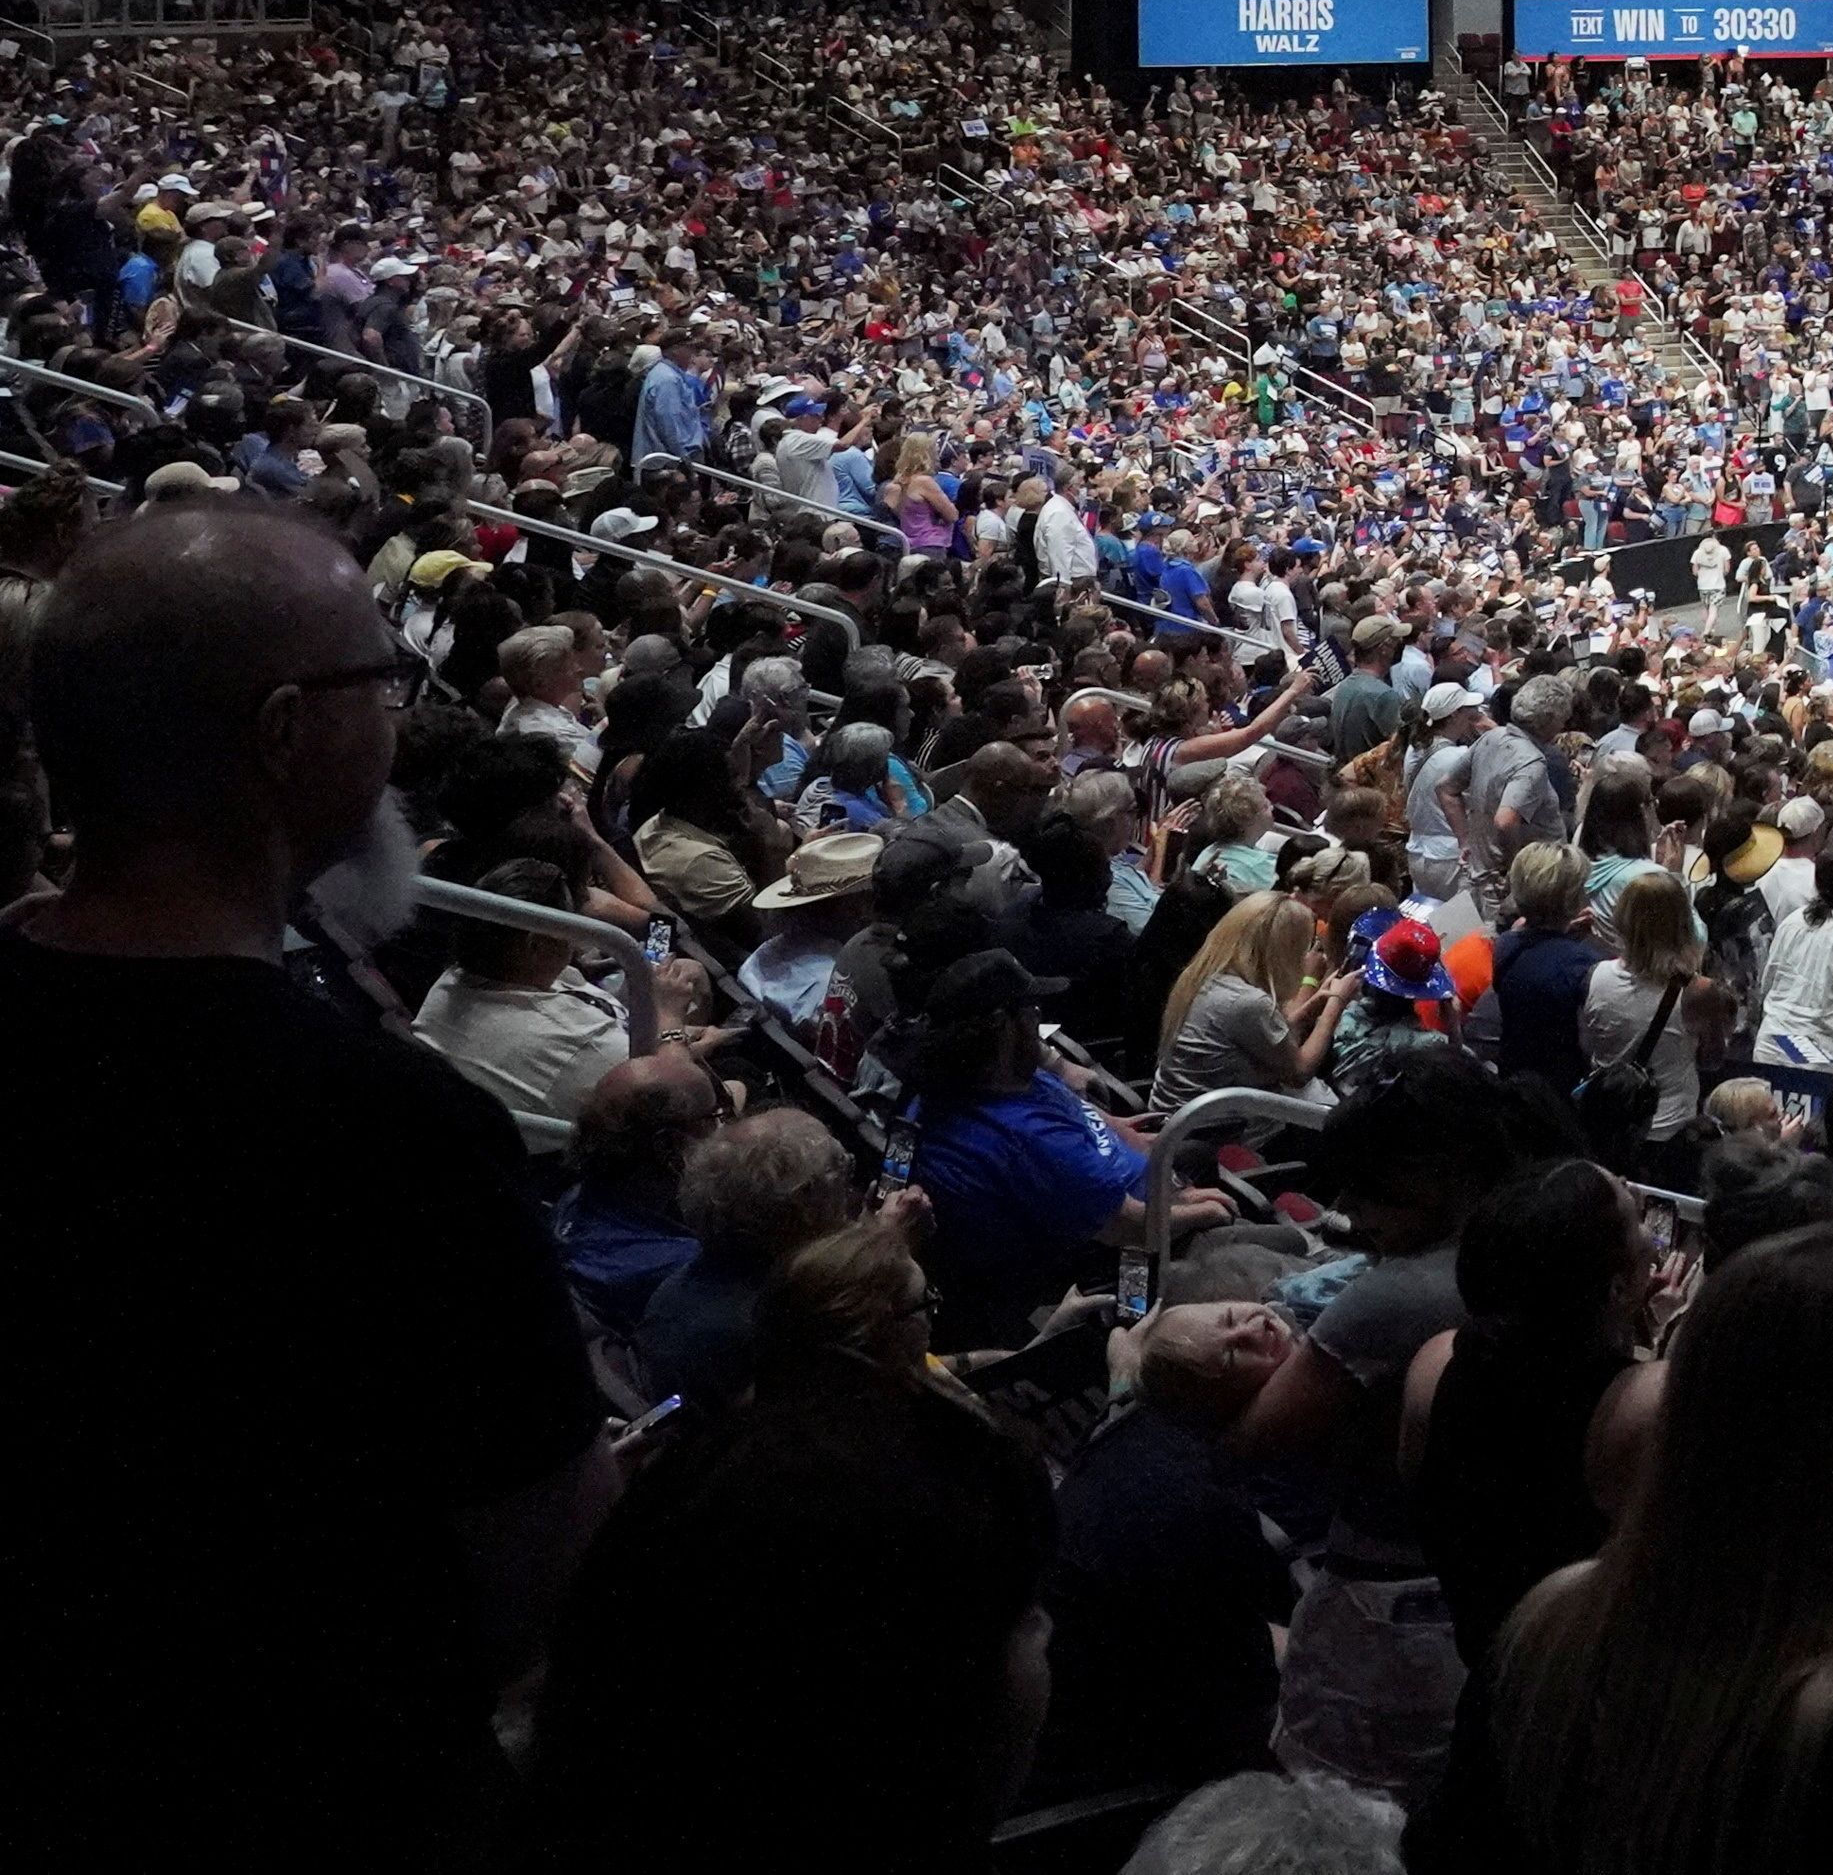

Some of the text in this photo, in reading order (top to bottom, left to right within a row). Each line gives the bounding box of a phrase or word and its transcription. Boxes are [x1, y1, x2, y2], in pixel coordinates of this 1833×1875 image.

[1571, 8, 1796, 42] TEXT WIN TO 30330
[1256, 34, 1319, 53] WALZ
[1314, 640, 1344, 684] HARRIS
